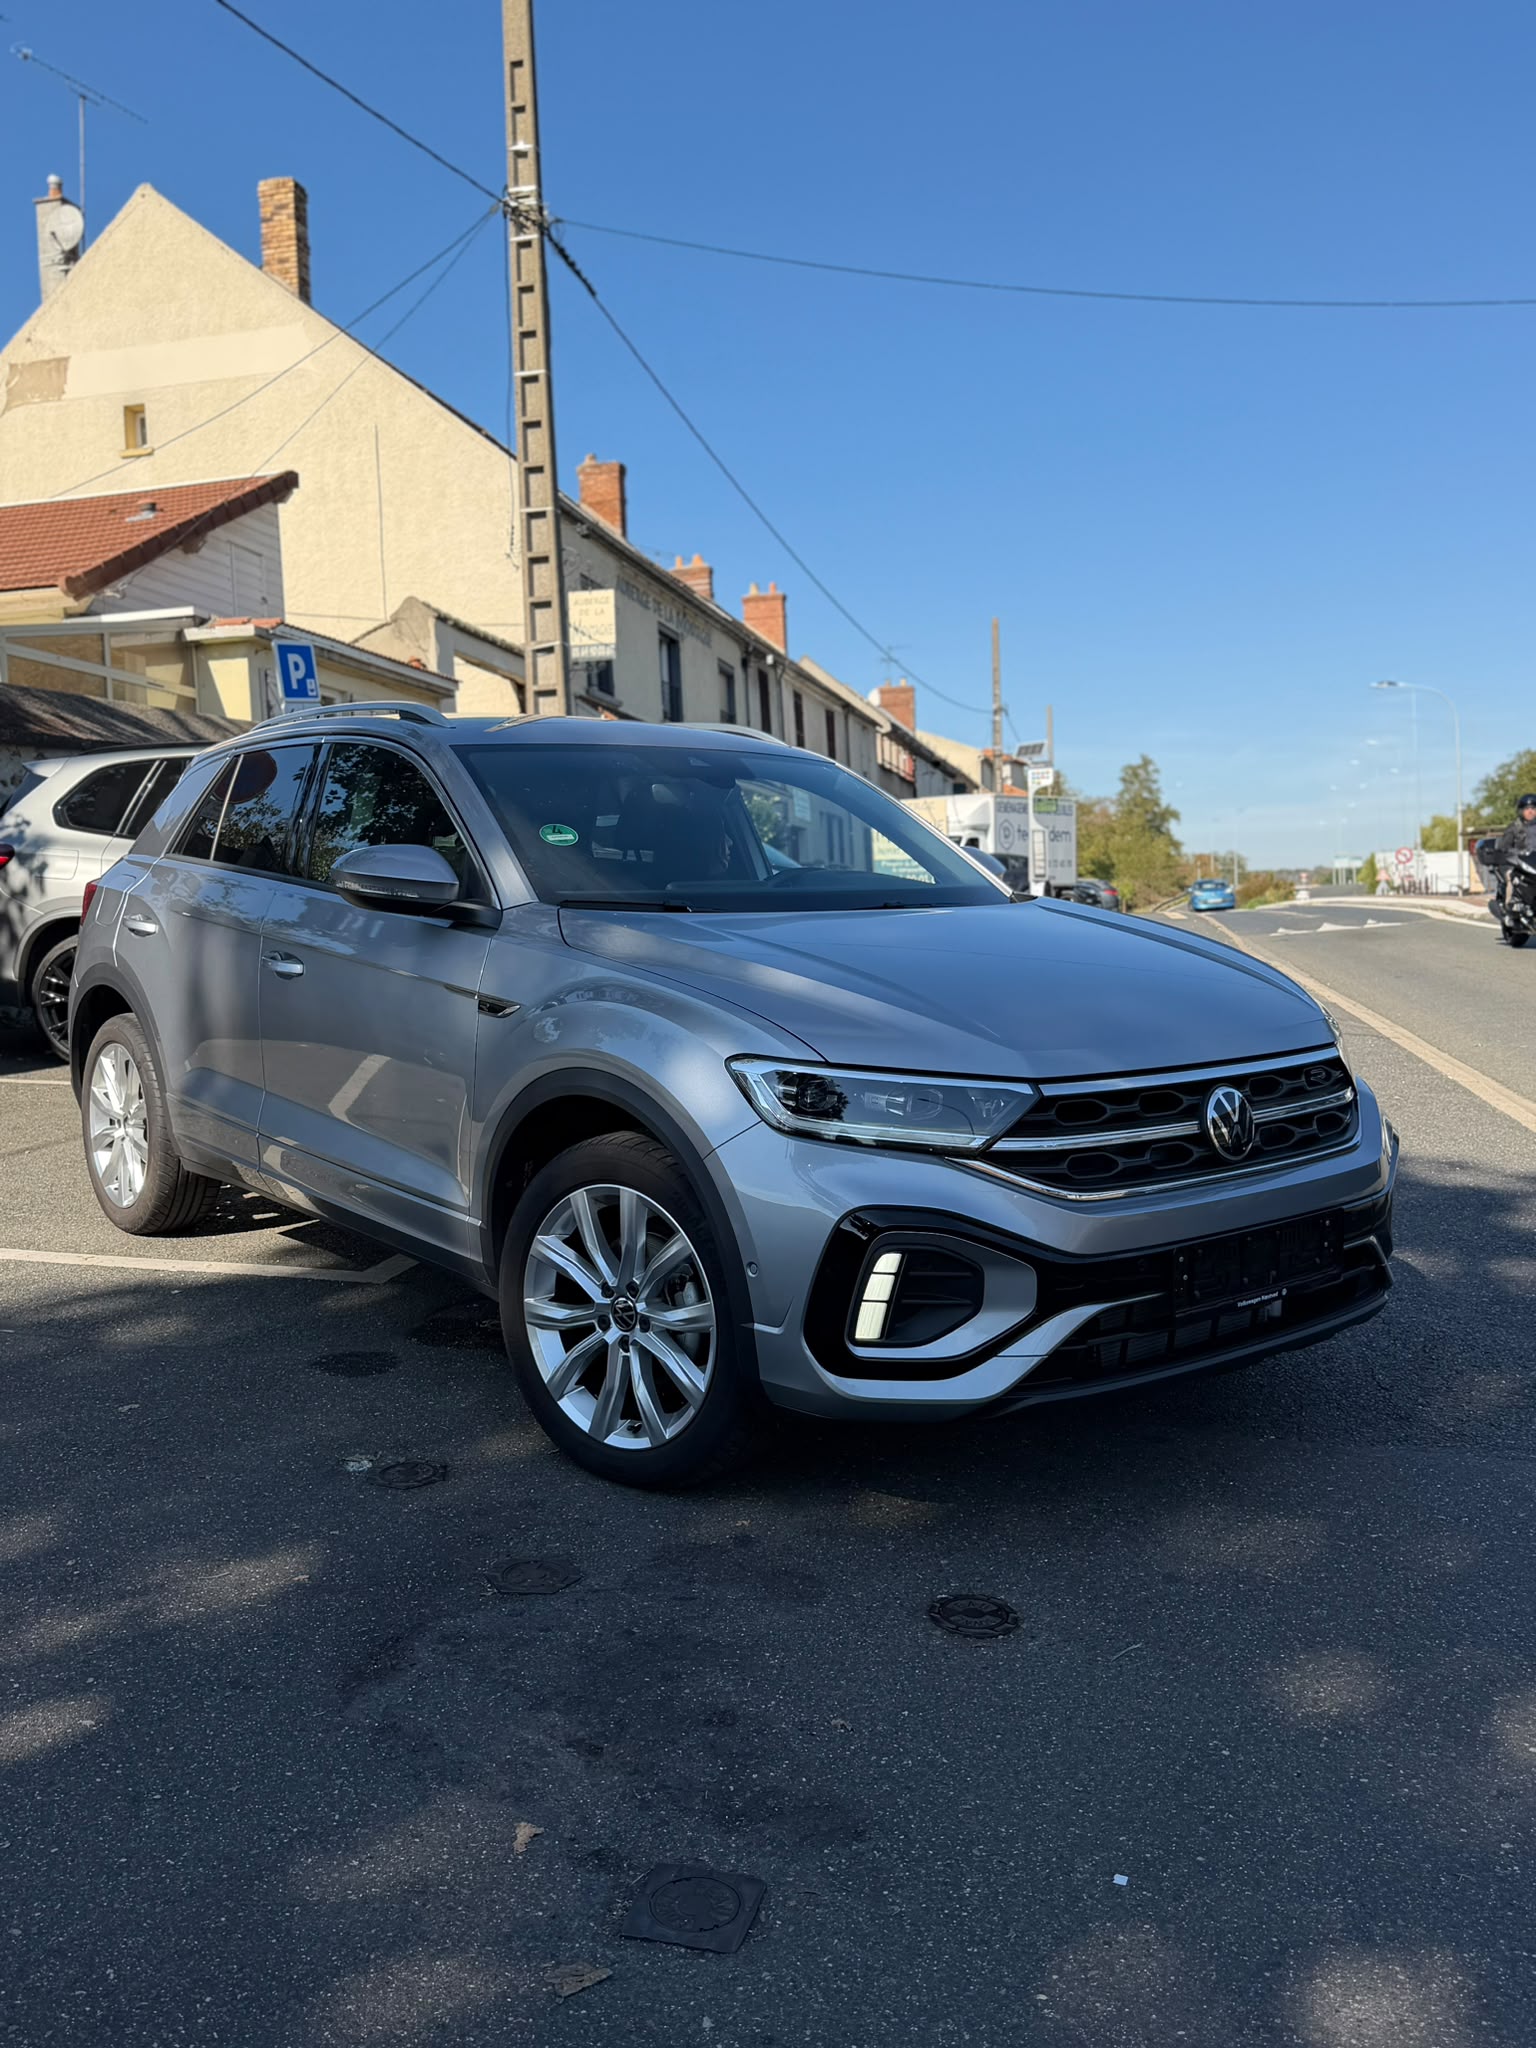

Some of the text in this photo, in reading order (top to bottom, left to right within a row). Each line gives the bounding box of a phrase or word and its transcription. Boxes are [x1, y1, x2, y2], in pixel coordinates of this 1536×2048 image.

[579, 607, 605, 616] DE LA
[287, 653, 306, 690] P
[552, 825, 562, 835] 4
[1237, 1297, 1261, 1307] Volkswagen
